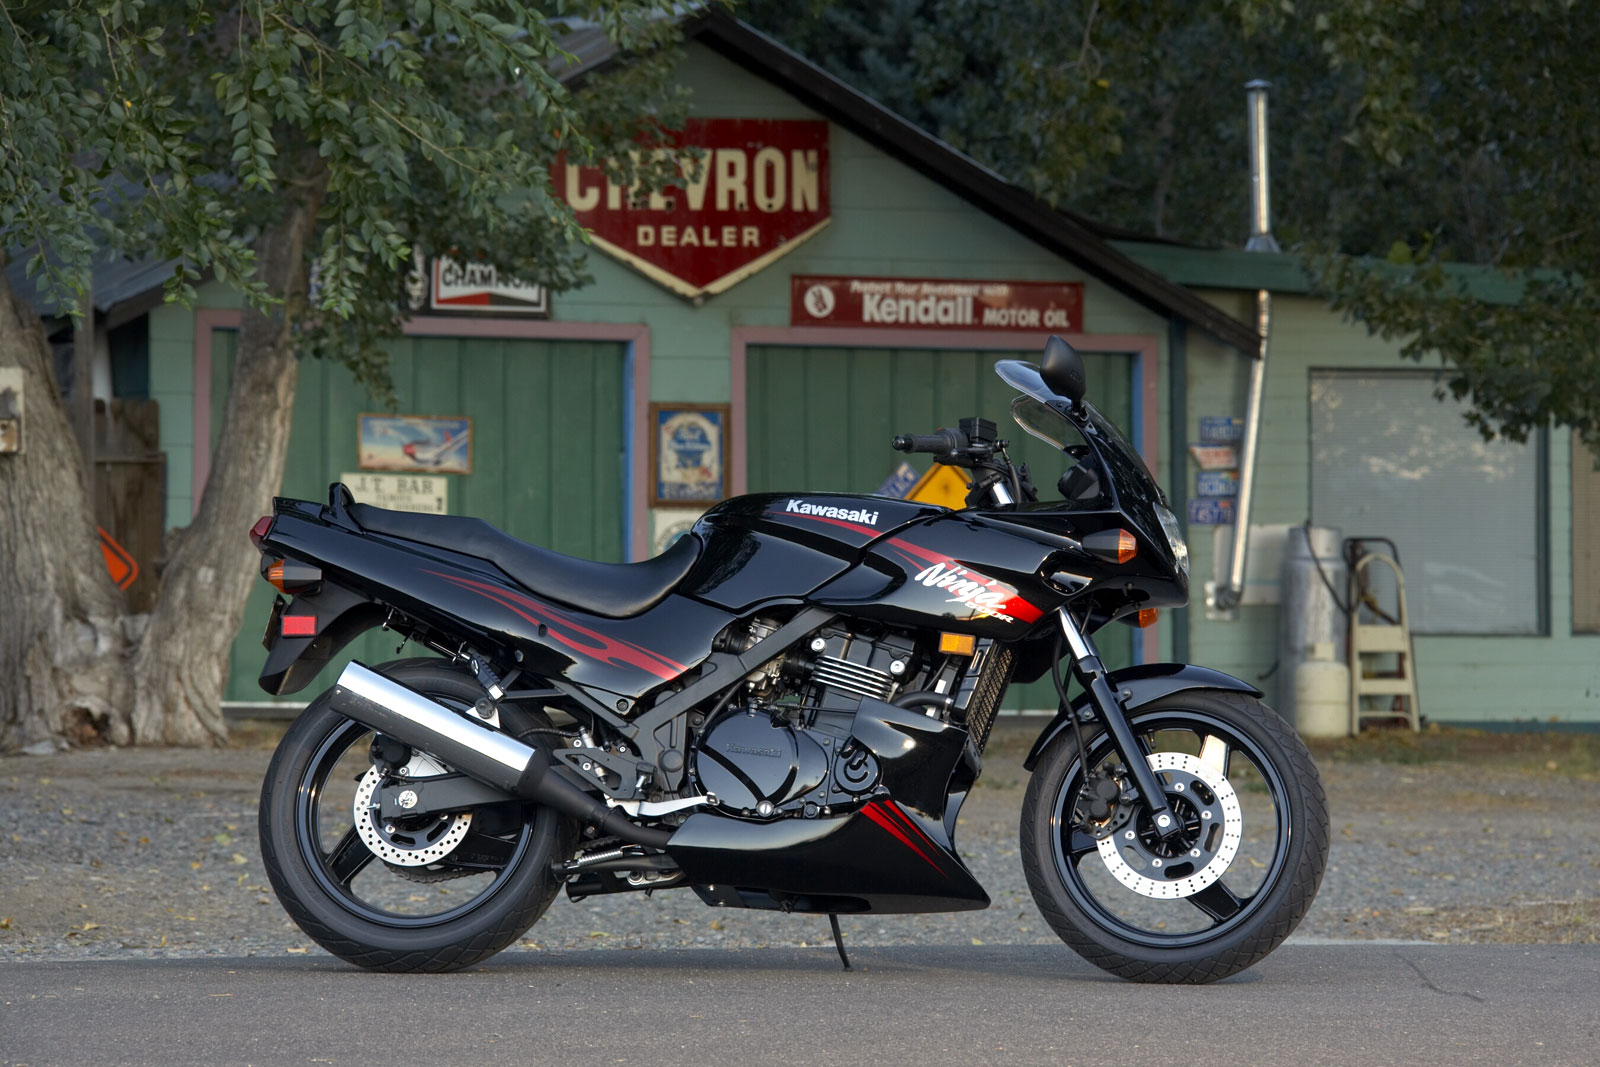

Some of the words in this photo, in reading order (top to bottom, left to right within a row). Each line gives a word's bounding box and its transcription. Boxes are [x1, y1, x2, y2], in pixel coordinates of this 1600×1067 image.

[637, 225, 760, 248] DEALER
[862, 294, 974, 325] Kendall
[983, 308, 1040, 327] MOTOR
[1043, 309, 1070, 327] OIL
[396, 478, 434, 494] BAR
[786, 499, 879, 526] Kawasaki
[914, 562, 1007, 609] Ninja
[965, 601, 1014, 624] 500R
[726, 743, 782, 758] Kawasaki
